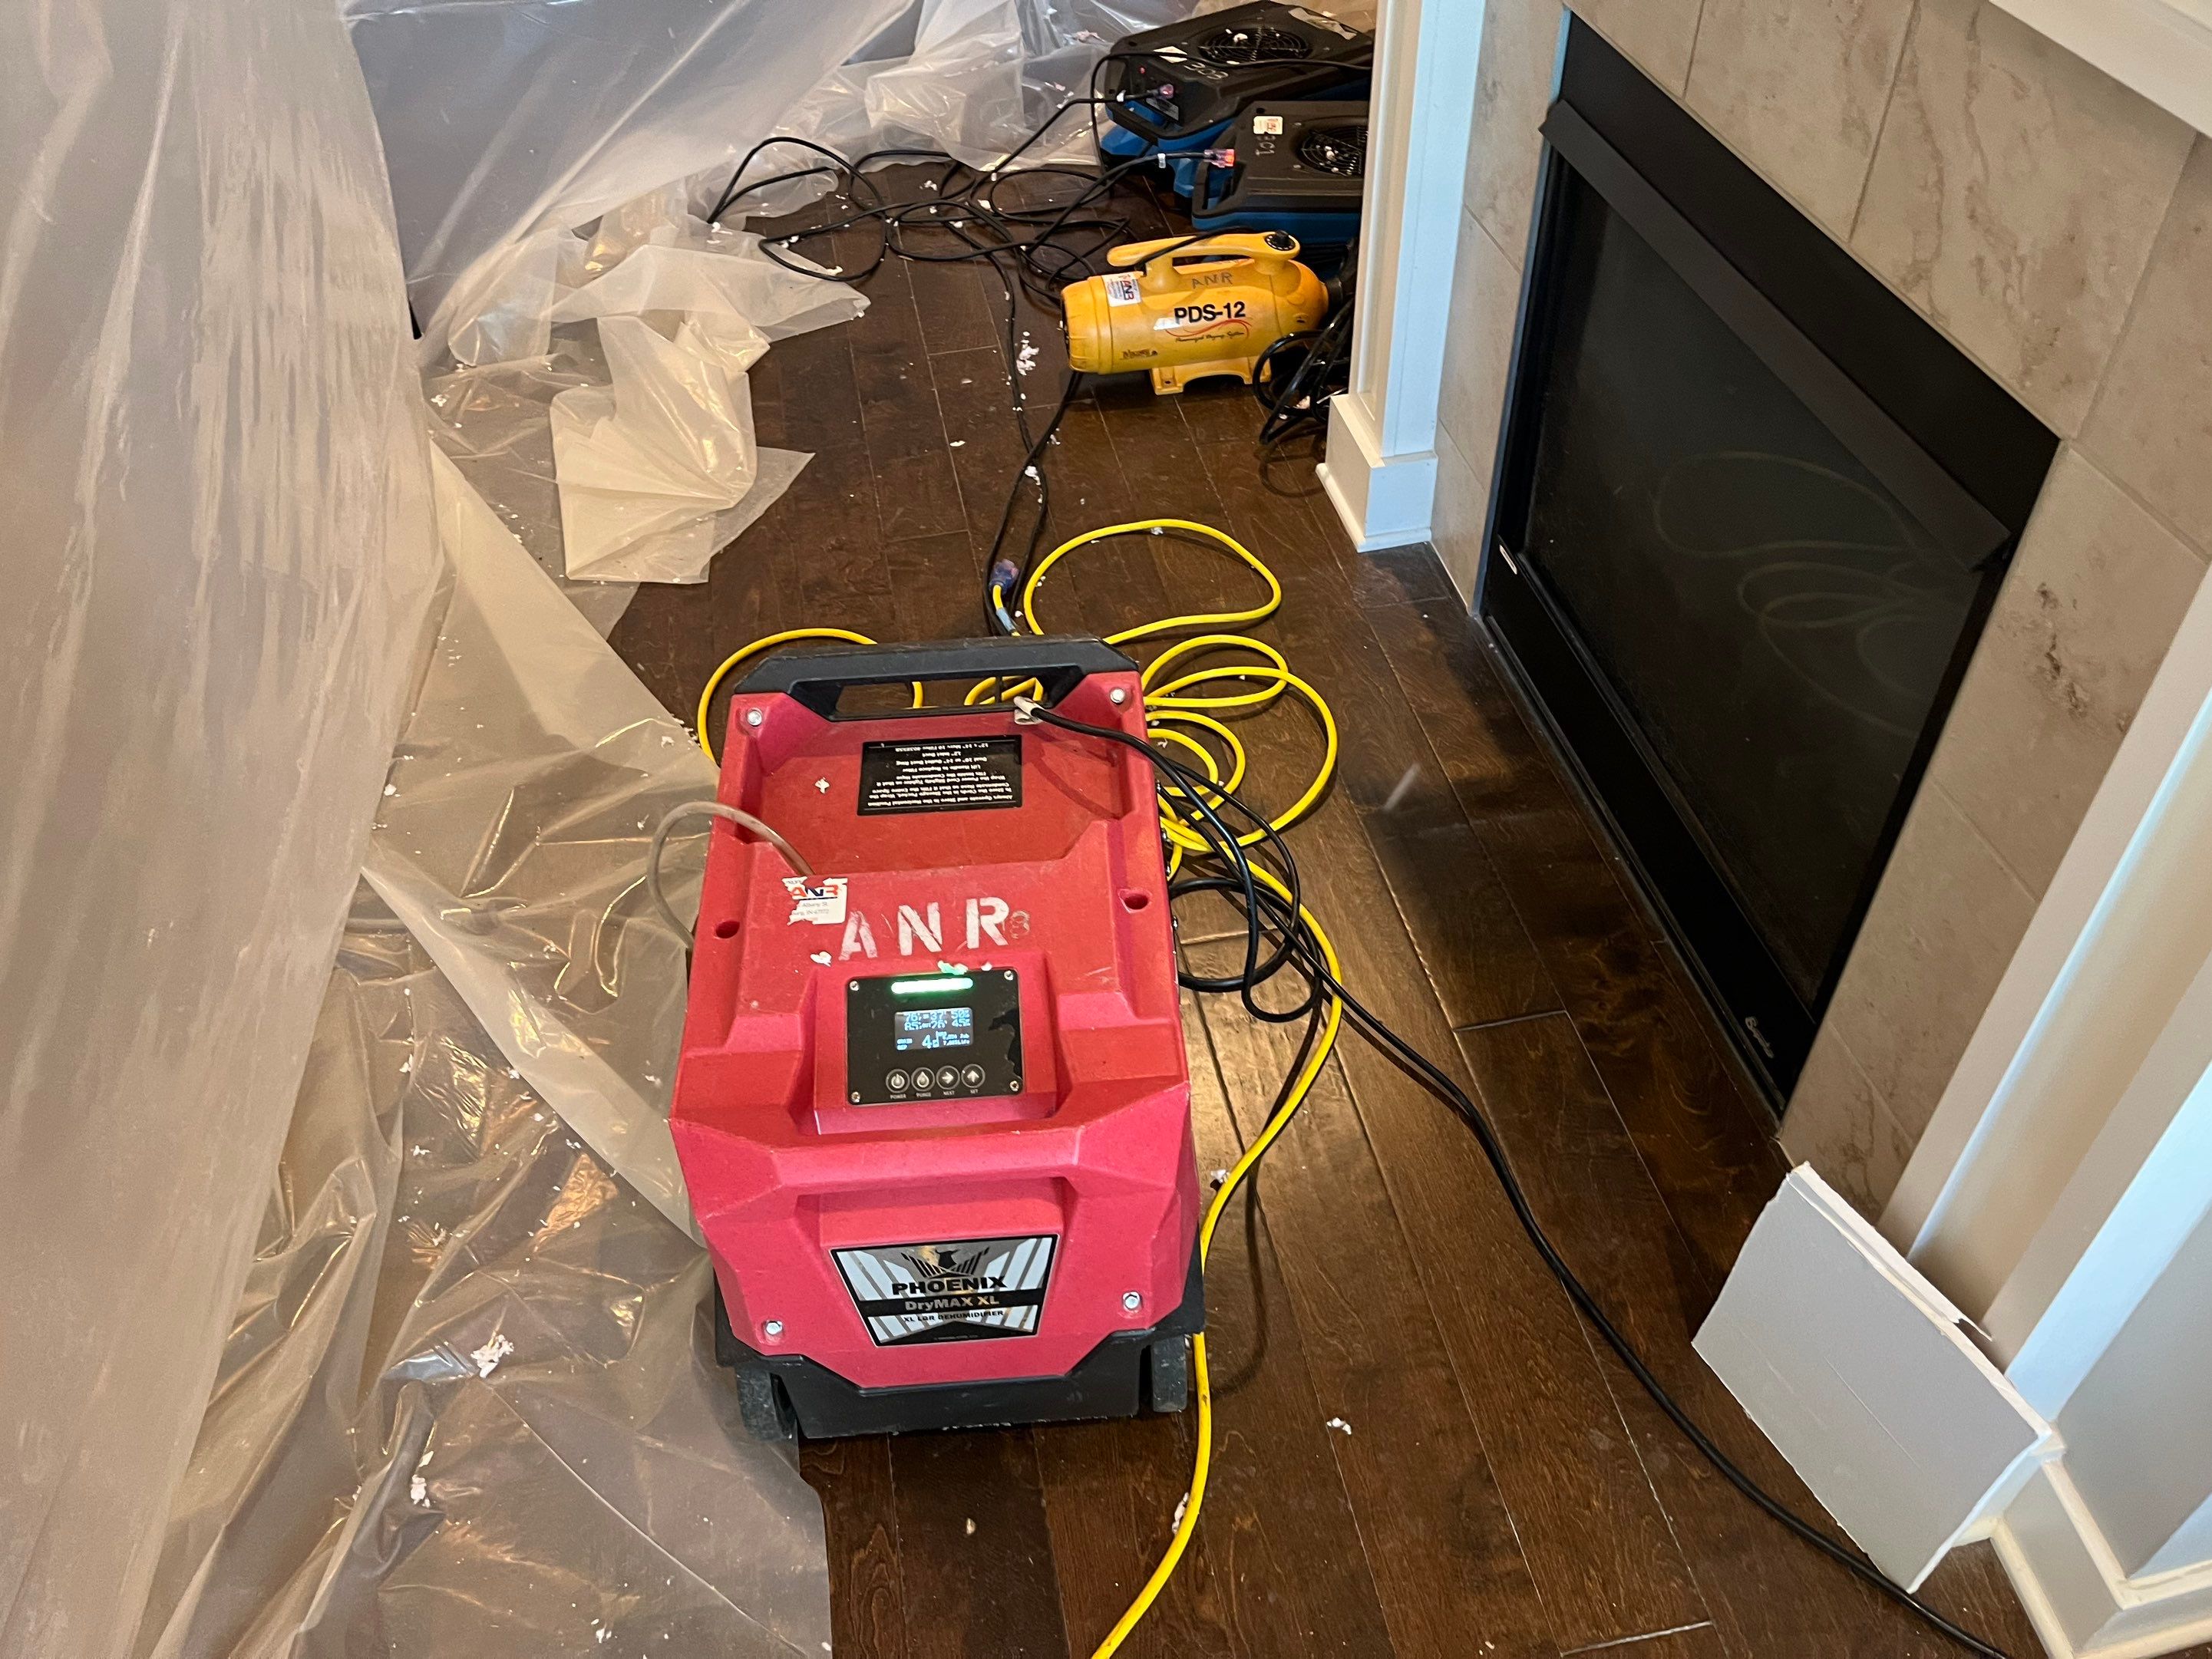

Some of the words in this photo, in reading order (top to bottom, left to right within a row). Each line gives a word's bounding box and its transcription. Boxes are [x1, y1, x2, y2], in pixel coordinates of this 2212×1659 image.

[1191, 272, 1233, 289] ANR
[1174, 302, 1246, 323] PDS-12
[790, 884, 839, 898] ANR
[838, 896, 1009, 960] ANR
[892, 1275, 1008, 1295] PHOENIX
[905, 1296, 974, 1312] DryMAX
[977, 1295, 1000, 1306] XL
[938, 1310, 1004, 1321] DEHUMIDIFIER
